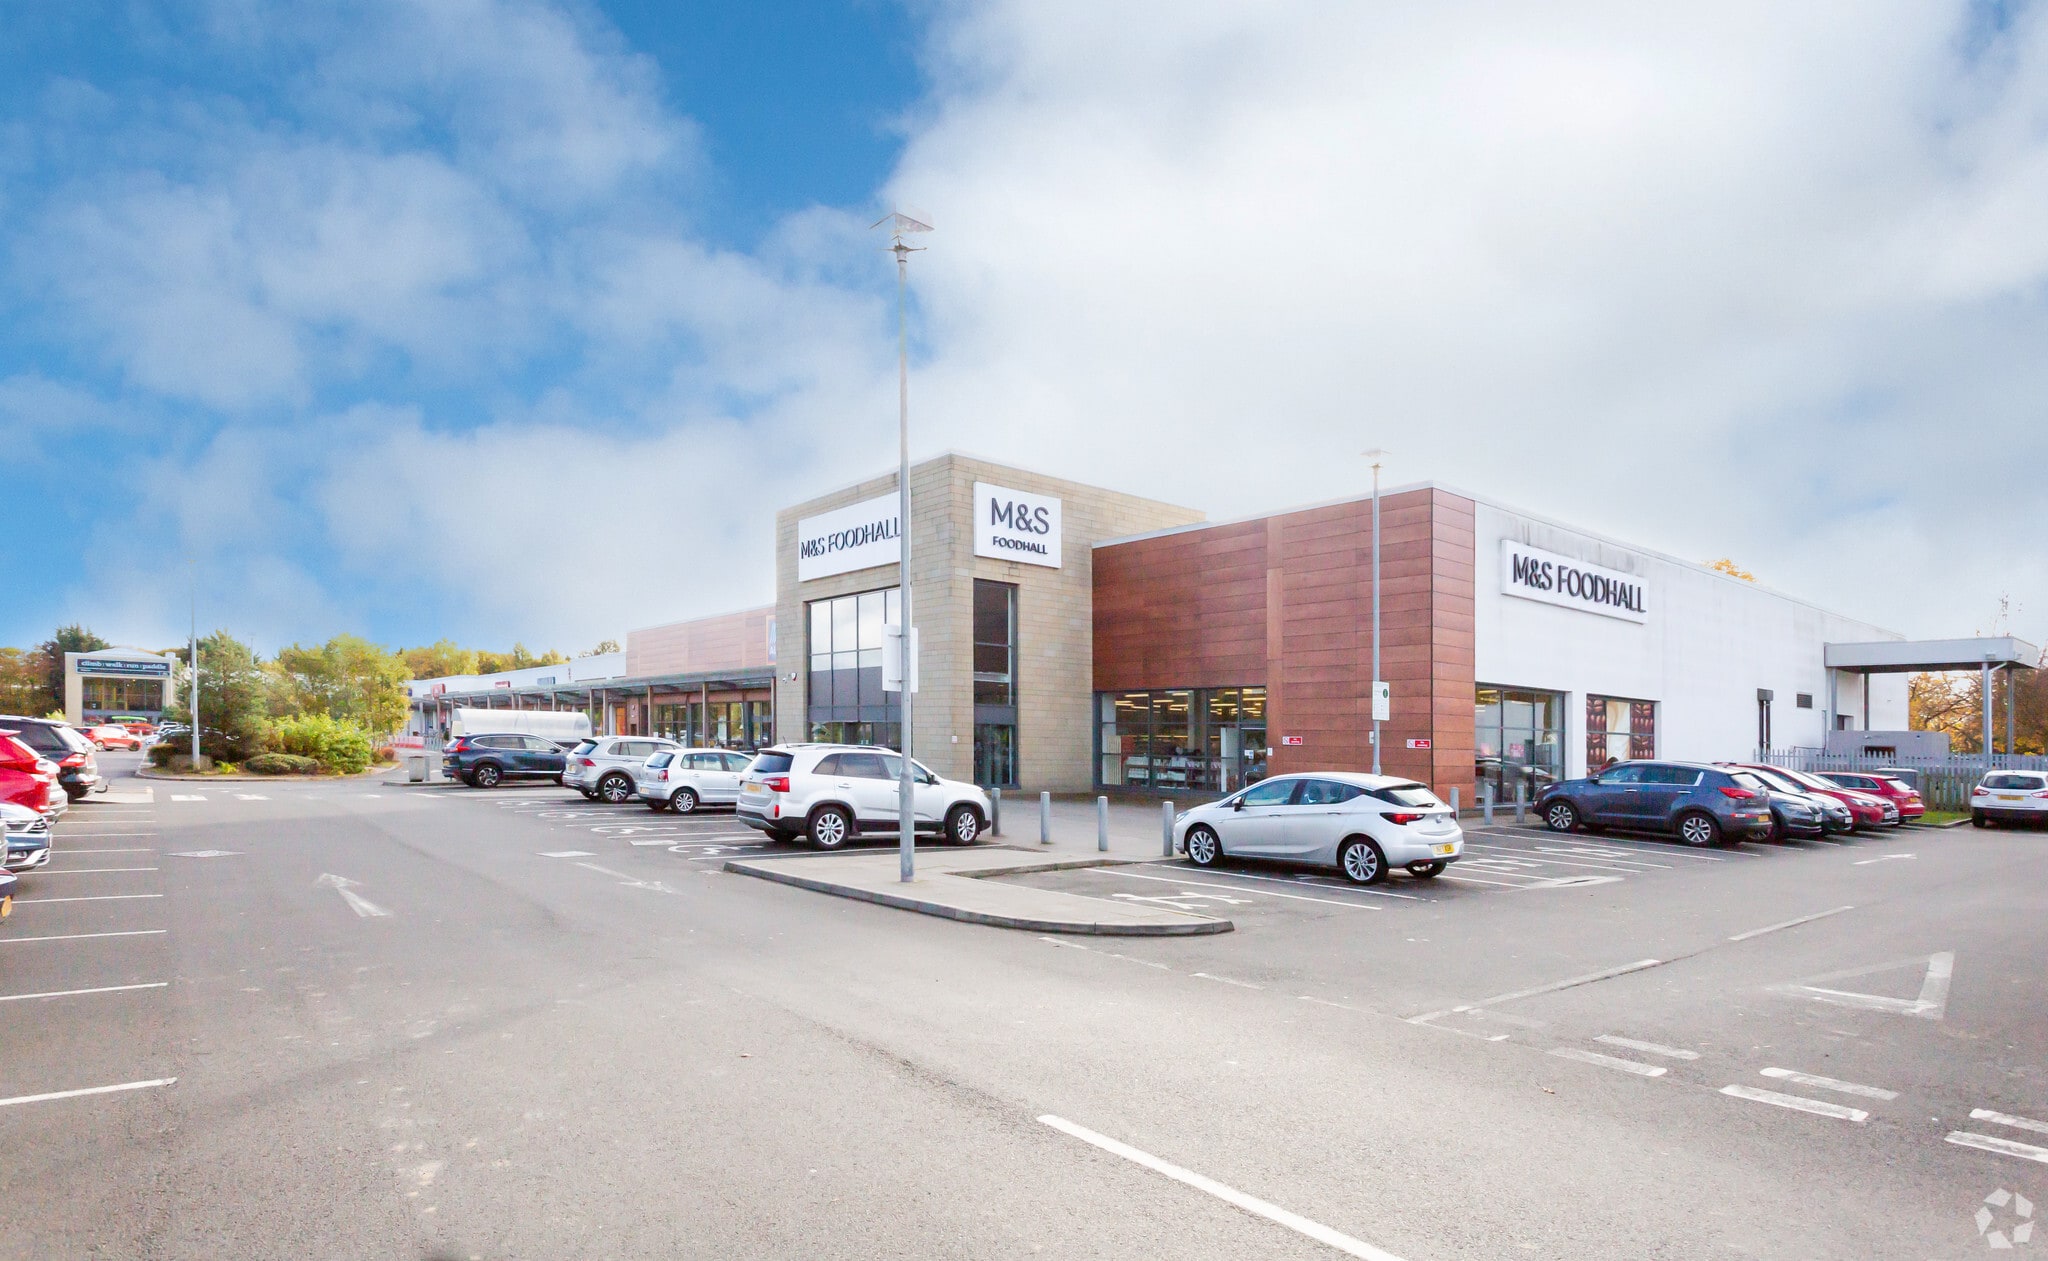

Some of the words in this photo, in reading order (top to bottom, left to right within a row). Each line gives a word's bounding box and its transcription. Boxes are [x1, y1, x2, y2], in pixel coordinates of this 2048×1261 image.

[991, 497, 1050, 535] M&S
[800, 537, 825, 560] M&S
[828, 516, 900, 553] FOODHALL
[992, 535, 1048, 555] FOODHALL
[1512, 552, 1553, 591] M&S
[1557, 564, 1647, 613] FOODHALL
